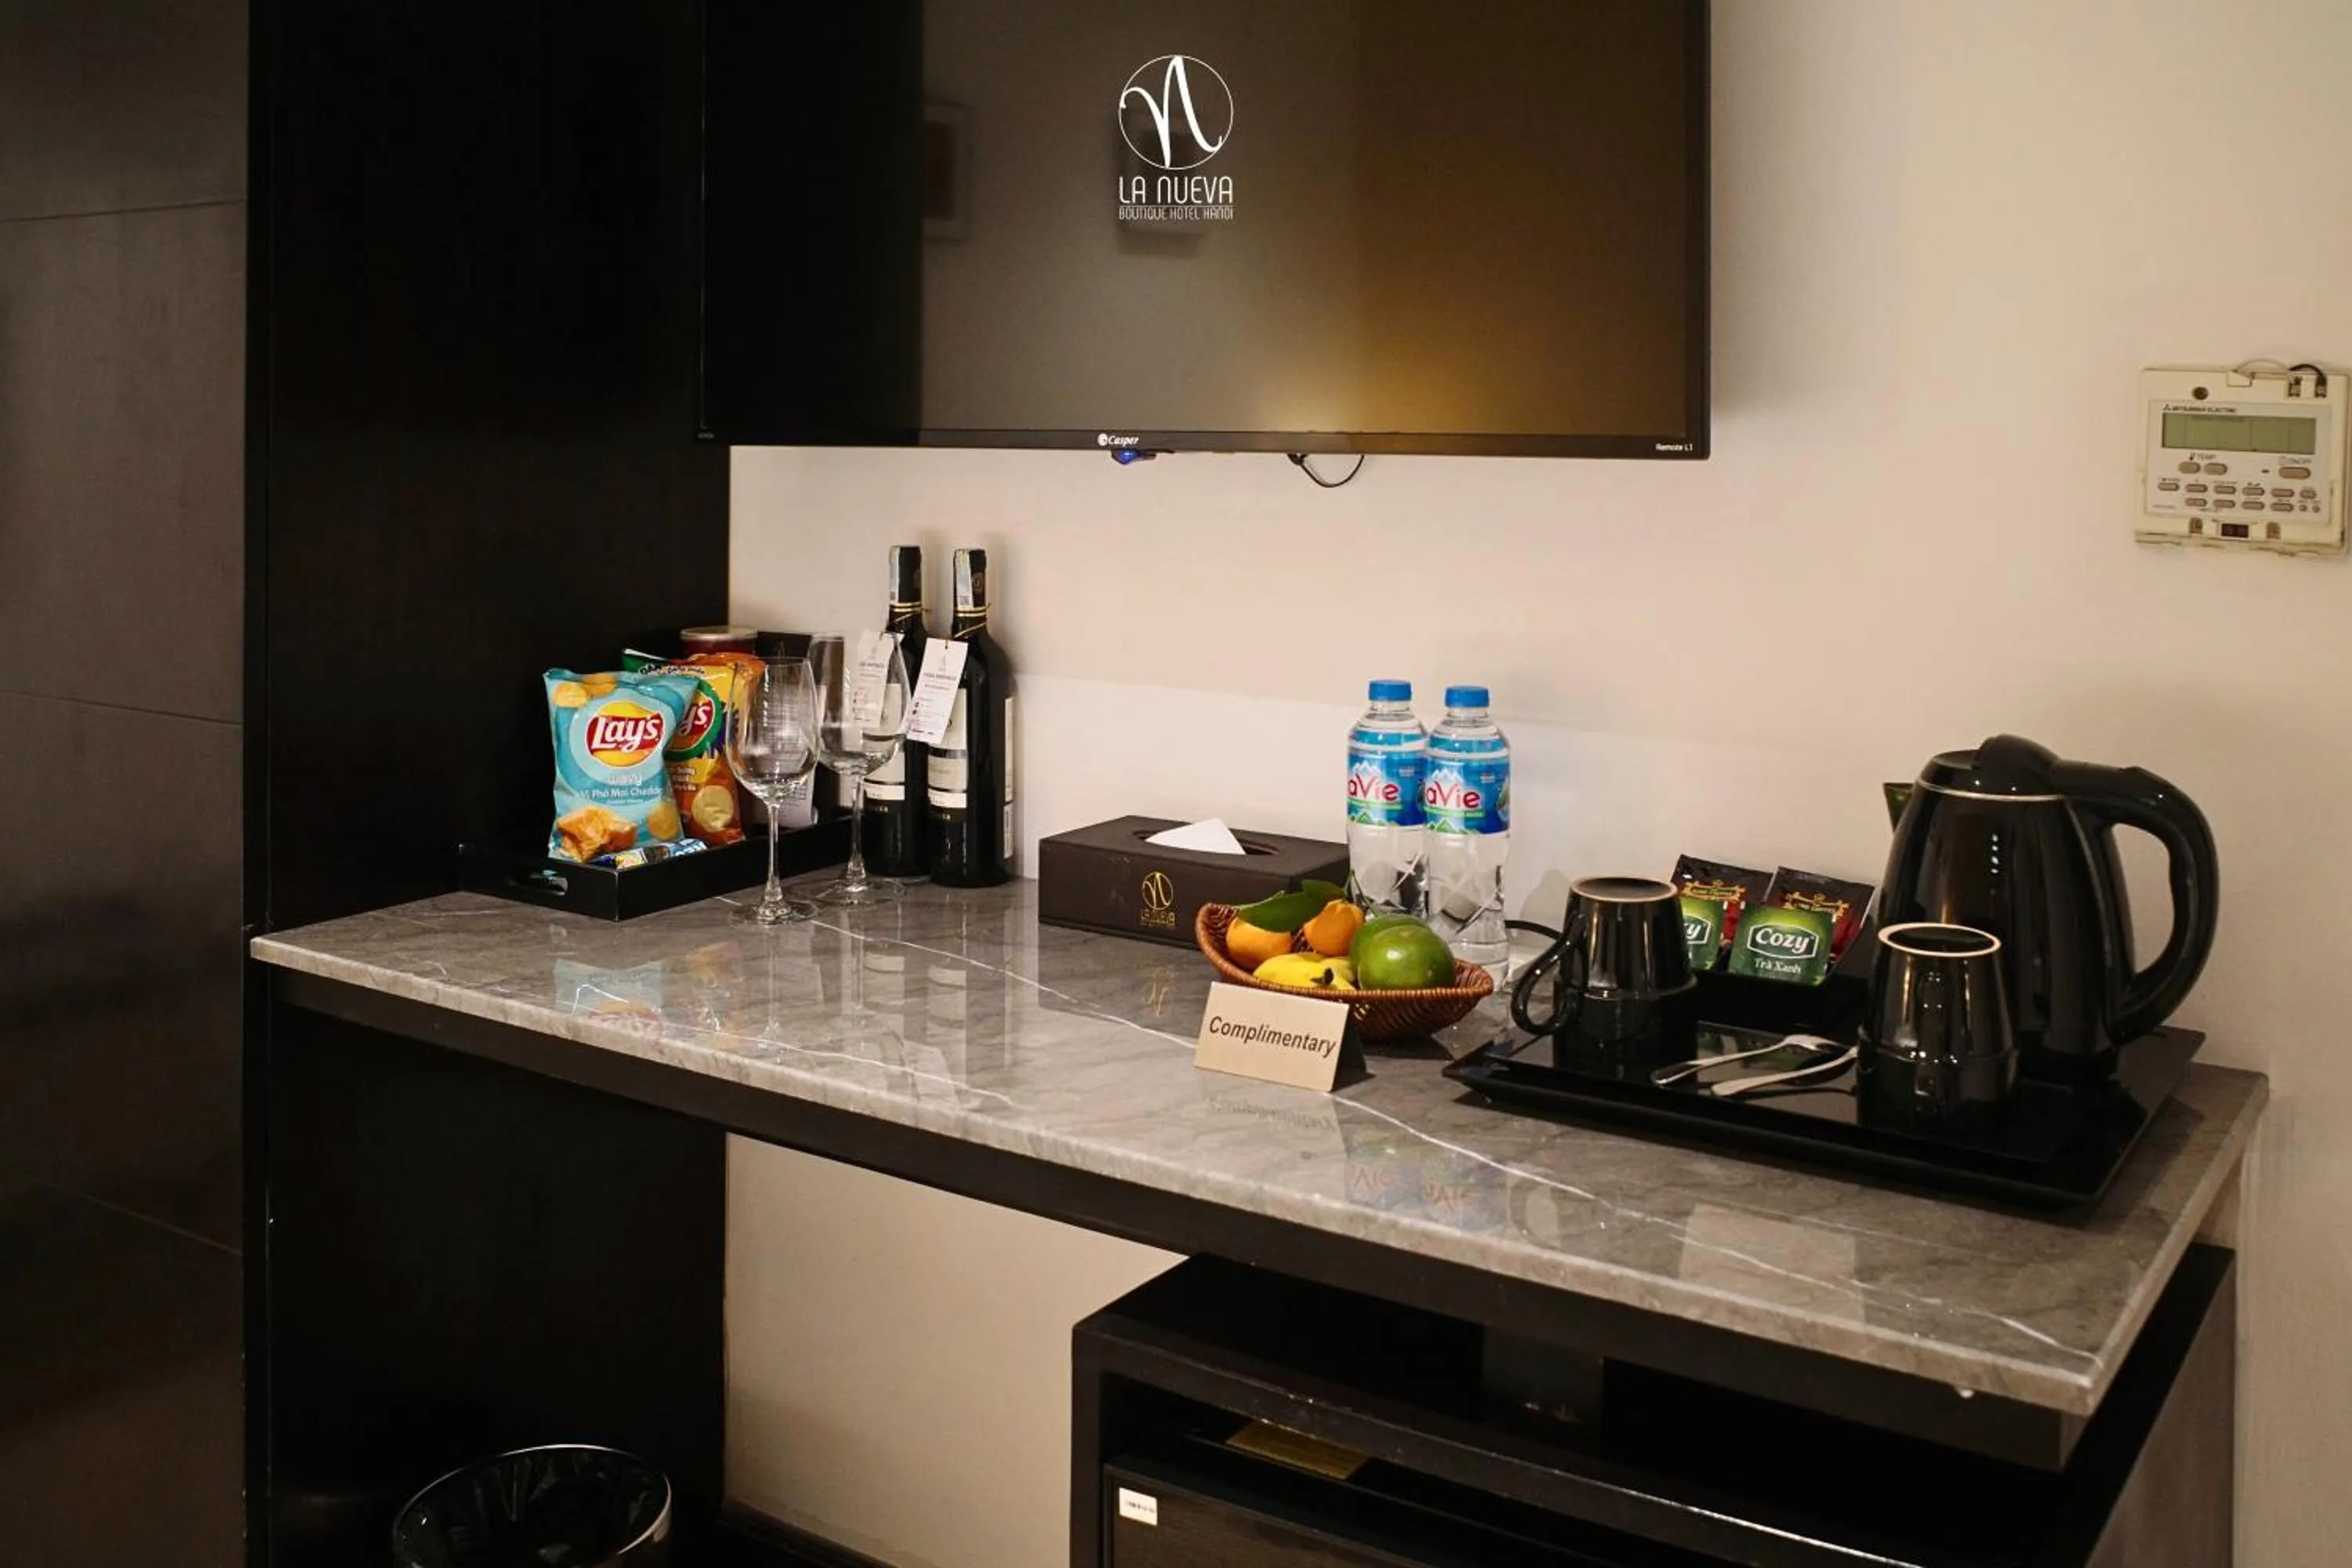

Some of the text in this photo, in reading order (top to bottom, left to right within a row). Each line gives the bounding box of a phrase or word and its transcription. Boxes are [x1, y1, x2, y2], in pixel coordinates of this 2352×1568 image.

[1119, 176, 1233, 205] LA NUEVA
[1119, 207, 1234, 220] BOUTIQUE HOTEL HANOI
[1108, 434, 1139, 448] Casper
[677, 701, 712, 736] y's
[591, 714, 660, 753] Lay's
[1348, 773, 1399, 801] aVie
[1426, 781, 1480, 808] aVie
[1755, 927, 1810, 954] Cozy
[1209, 1015, 1338, 1058] Complimentary
